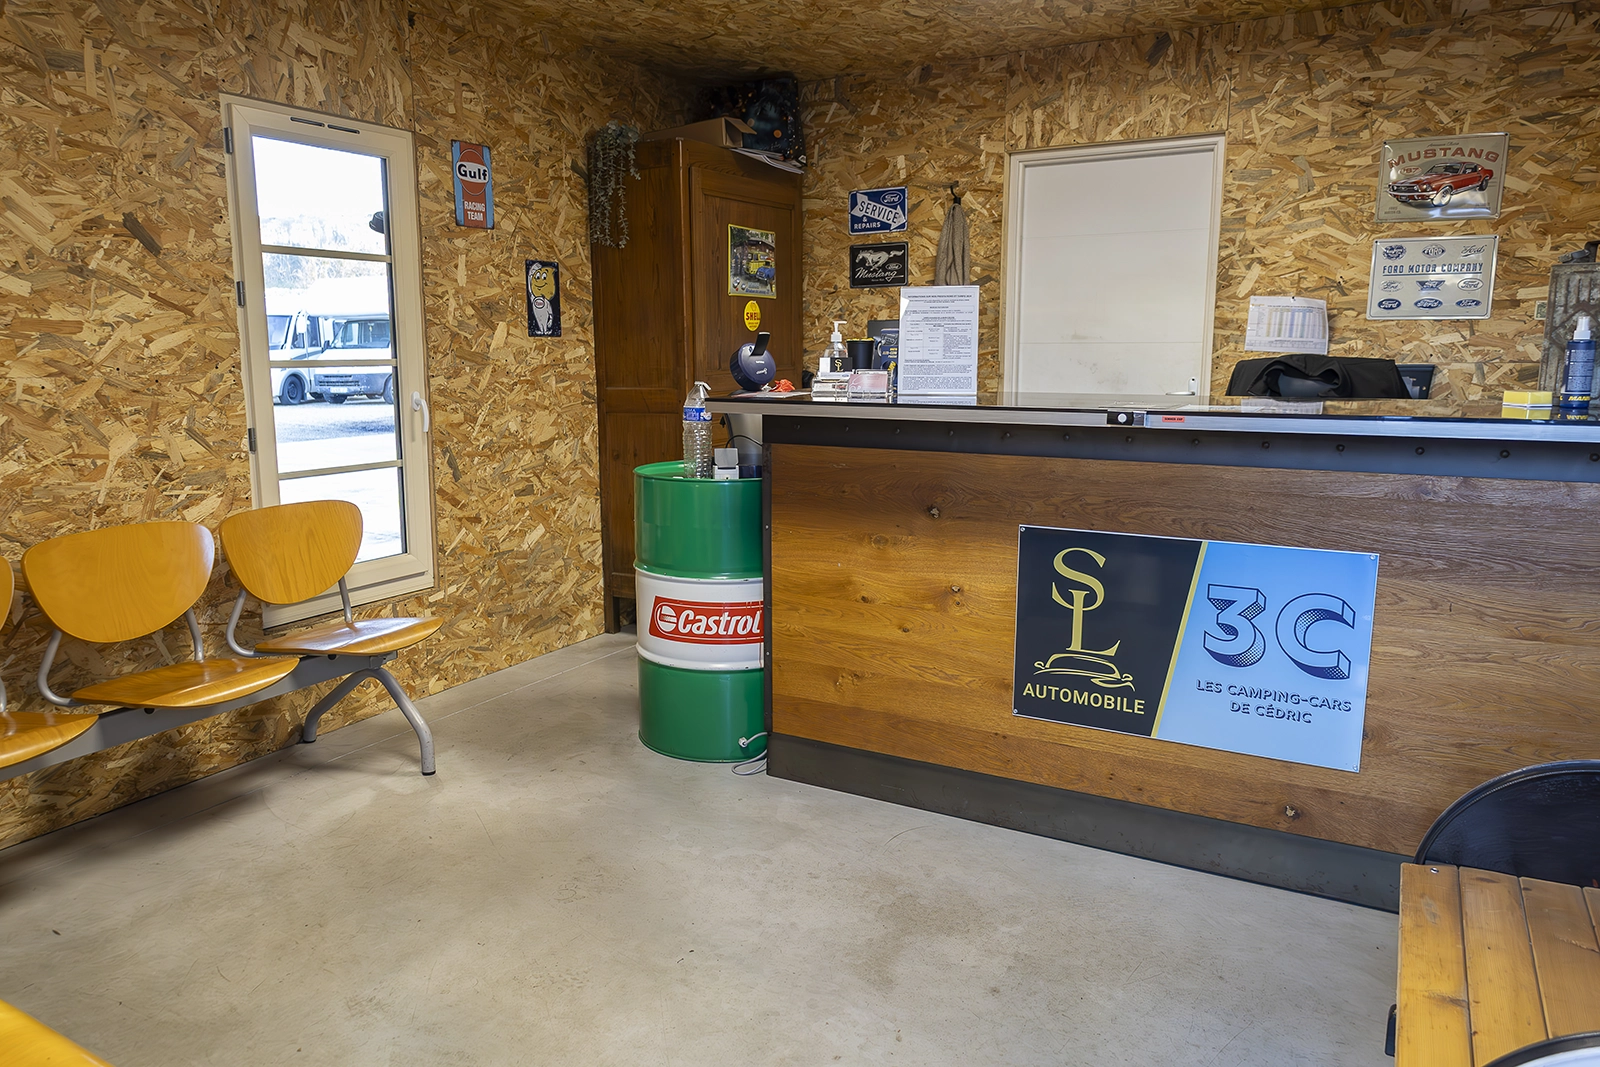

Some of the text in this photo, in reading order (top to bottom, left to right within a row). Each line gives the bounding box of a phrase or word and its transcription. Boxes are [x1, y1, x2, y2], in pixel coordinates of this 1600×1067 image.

[1388, 147, 1499, 168] MUSTANG
[458, 163, 488, 181] Gulf
[464, 201, 486, 211] RACING
[858, 200, 899, 224] SERVICE
[467, 211, 484, 221] TEAM
[855, 267, 904, 282] Mustang
[1382, 262, 1484, 274] FORD MOTOR COMPANY
[1461, 280, 1480, 289] Ford
[1380, 301, 1400, 309] Ford
[677, 609, 762, 635] Castrol
[1203, 583, 1357, 681] 3C
[1021, 682, 1146, 715] AUTOMOBILE
[1195, 678, 1353, 714] LES CAMPING-CARS
[1229, 699, 1313, 724] DE CÉDRIC
